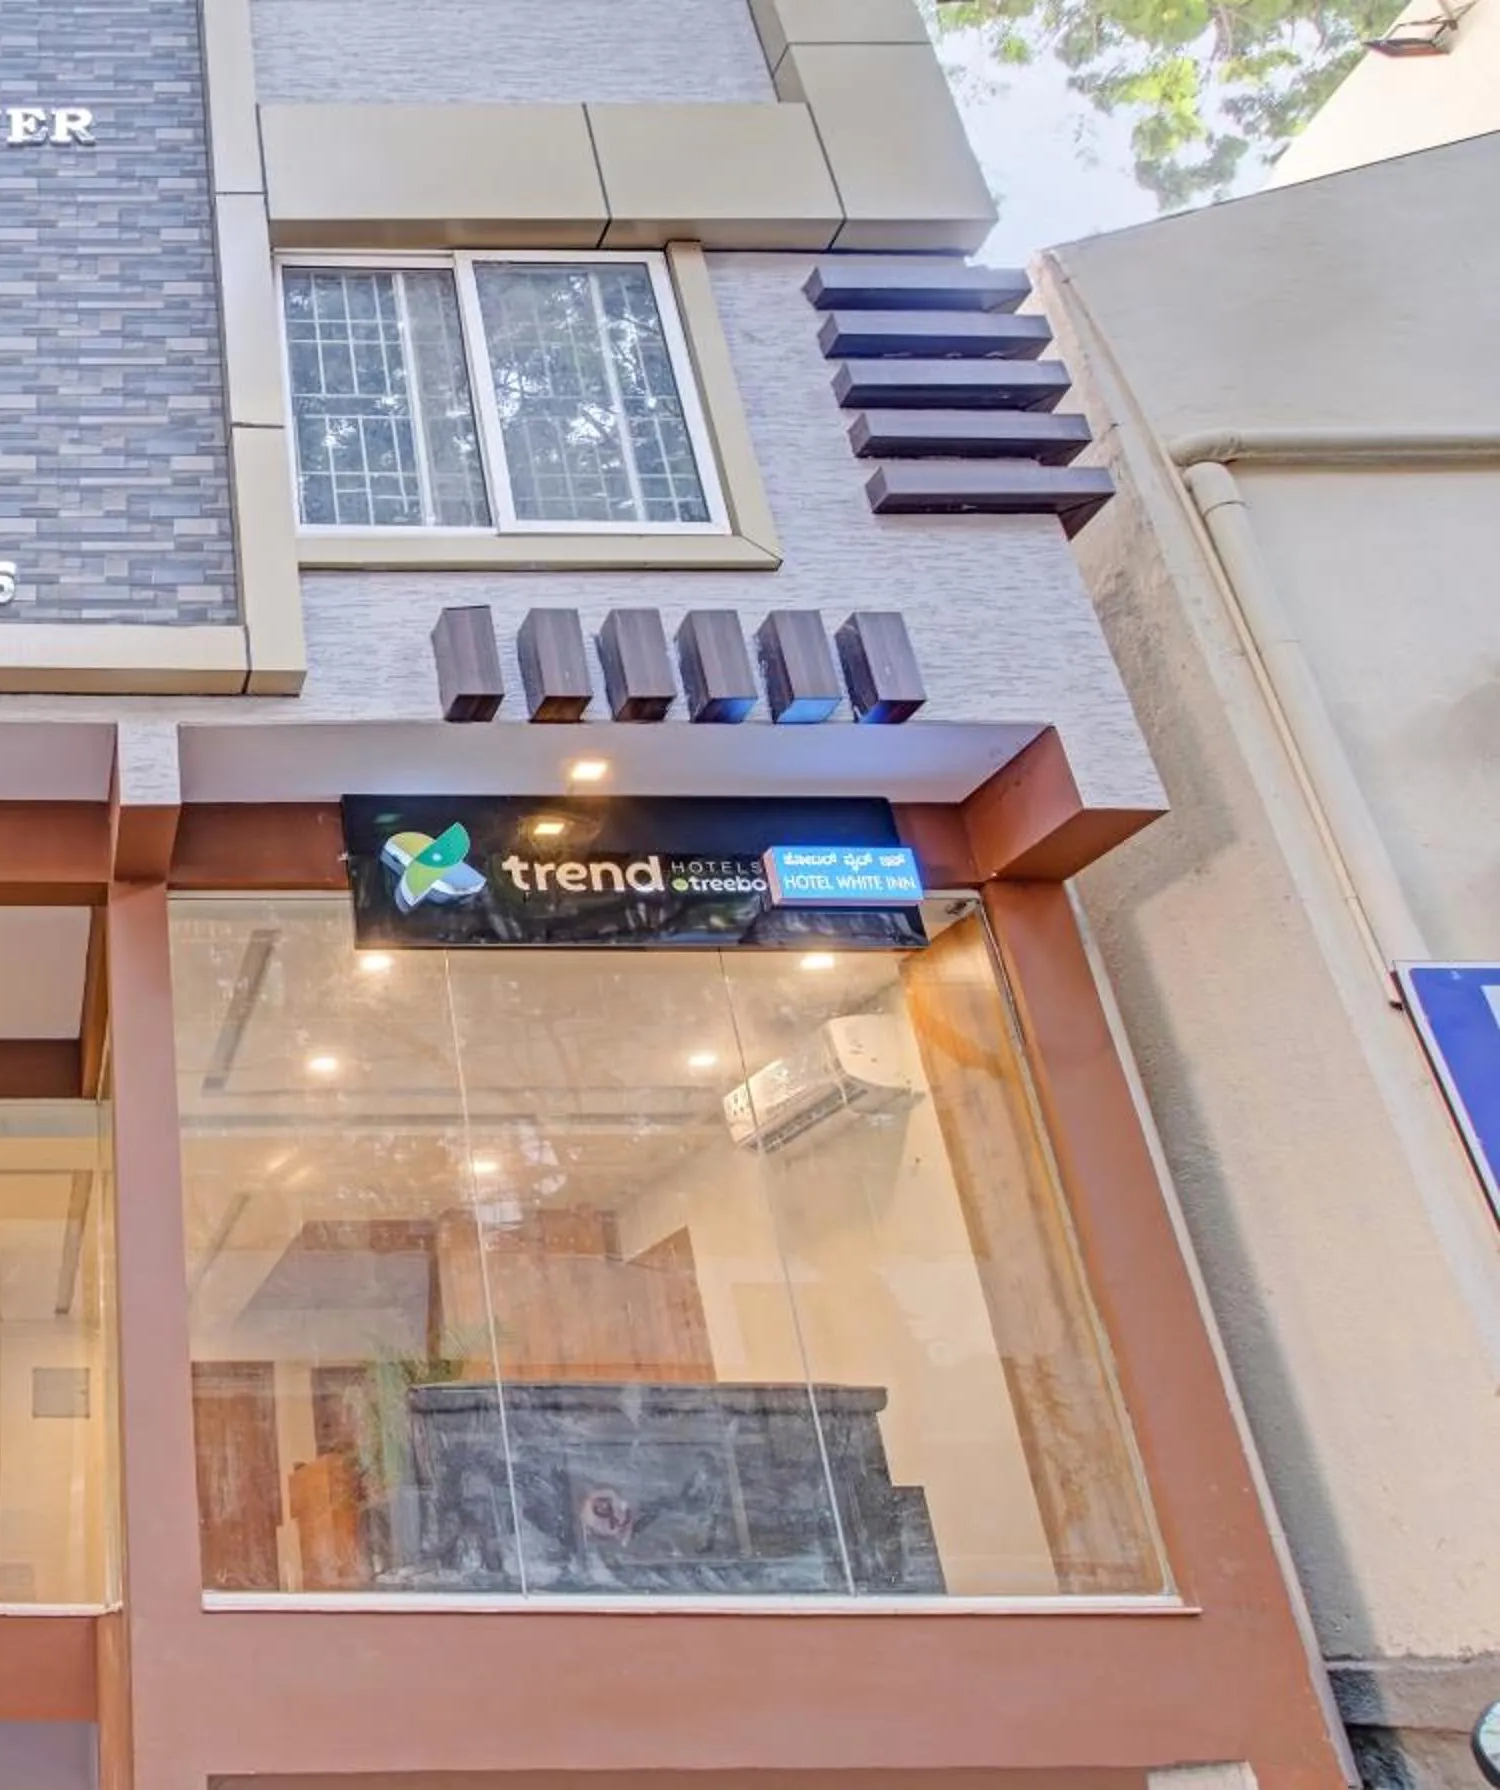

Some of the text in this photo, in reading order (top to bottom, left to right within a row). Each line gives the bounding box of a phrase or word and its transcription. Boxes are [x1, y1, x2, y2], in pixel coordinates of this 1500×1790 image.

[502, 855, 665, 893] trend
[671, 860, 763, 875] HOTELS
[688, 876, 767, 891] treebo
[784, 874, 917, 890] HOTEL WHITE INN
